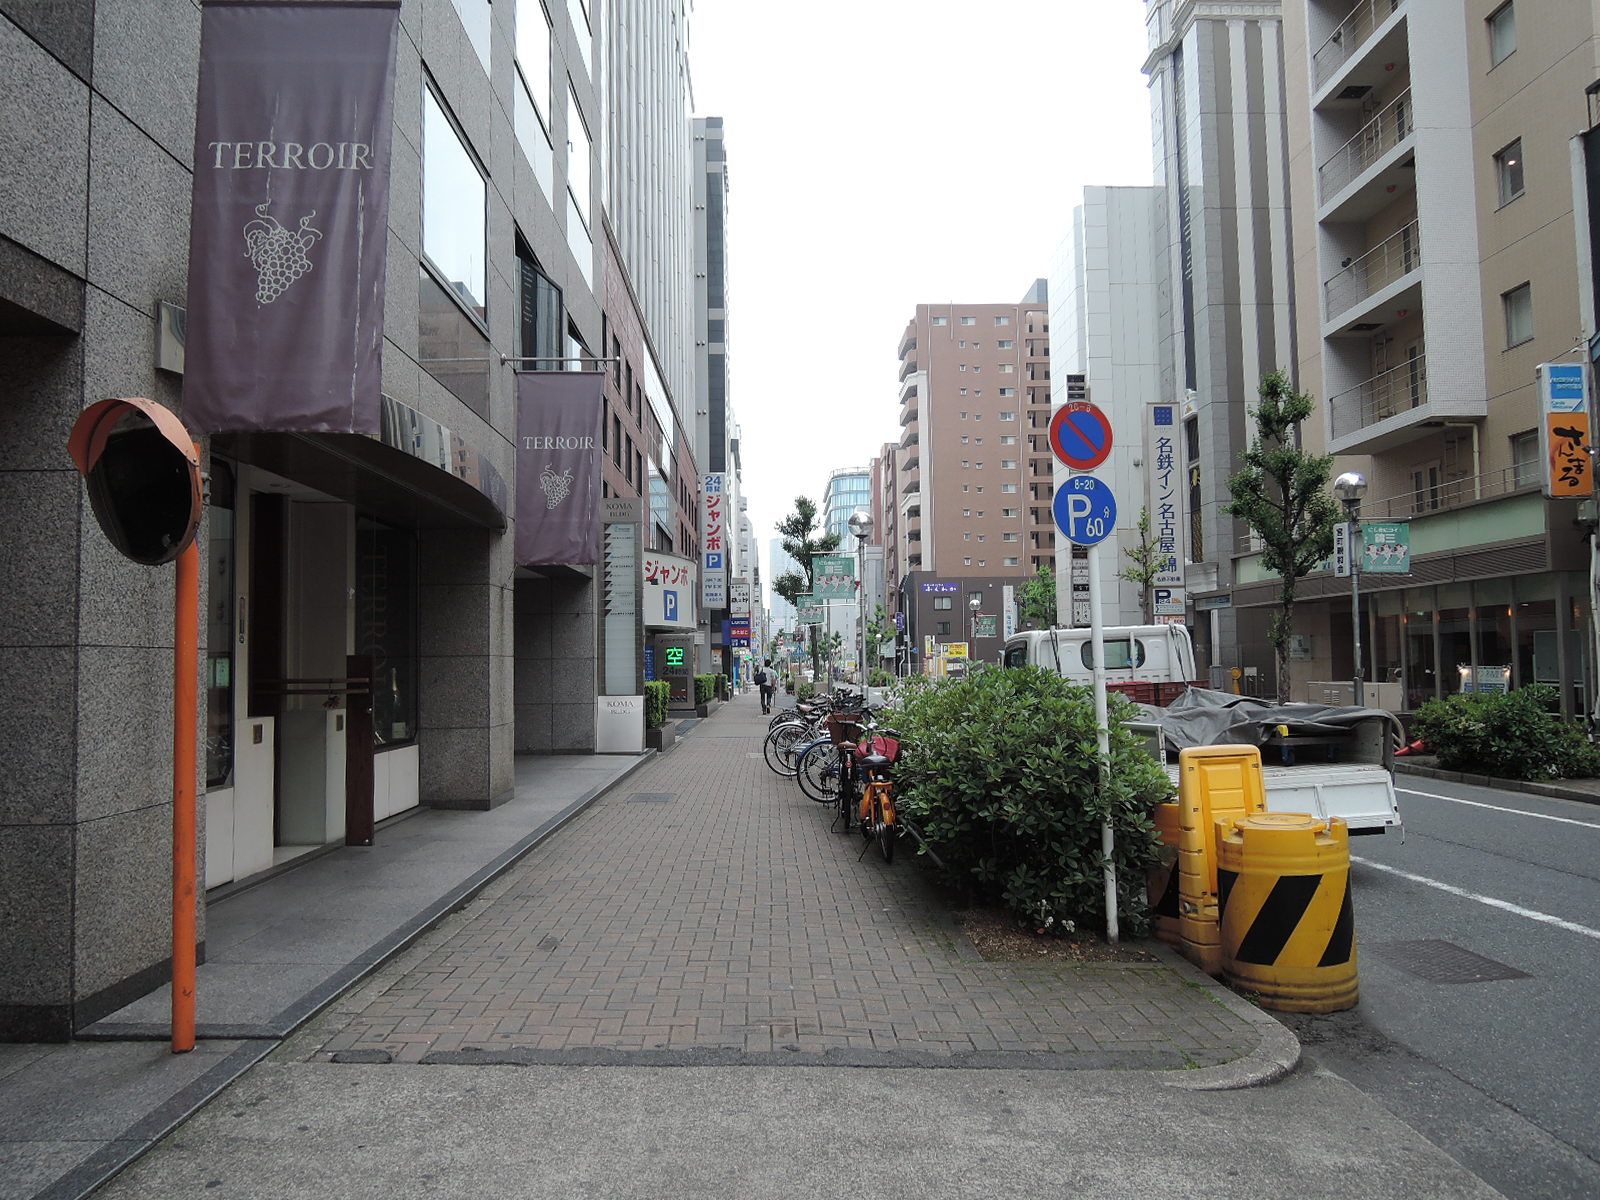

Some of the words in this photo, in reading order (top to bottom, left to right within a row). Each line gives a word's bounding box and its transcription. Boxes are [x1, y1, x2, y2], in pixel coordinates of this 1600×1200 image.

[208, 141, 374, 171] TERROIR
[522, 436, 595, 450] TERROIR
[704, 475, 722, 486] 24
[1074, 479, 1095, 490] 8-20
[606, 503, 633, 511] KOMA
[1067, 493, 1093, 537] P
[705, 495, 721, 550] ジャンボ
[1085, 518, 1104, 537] 60
[645, 559, 689, 587] ジャンボ
[666, 647, 684, 665] 空
